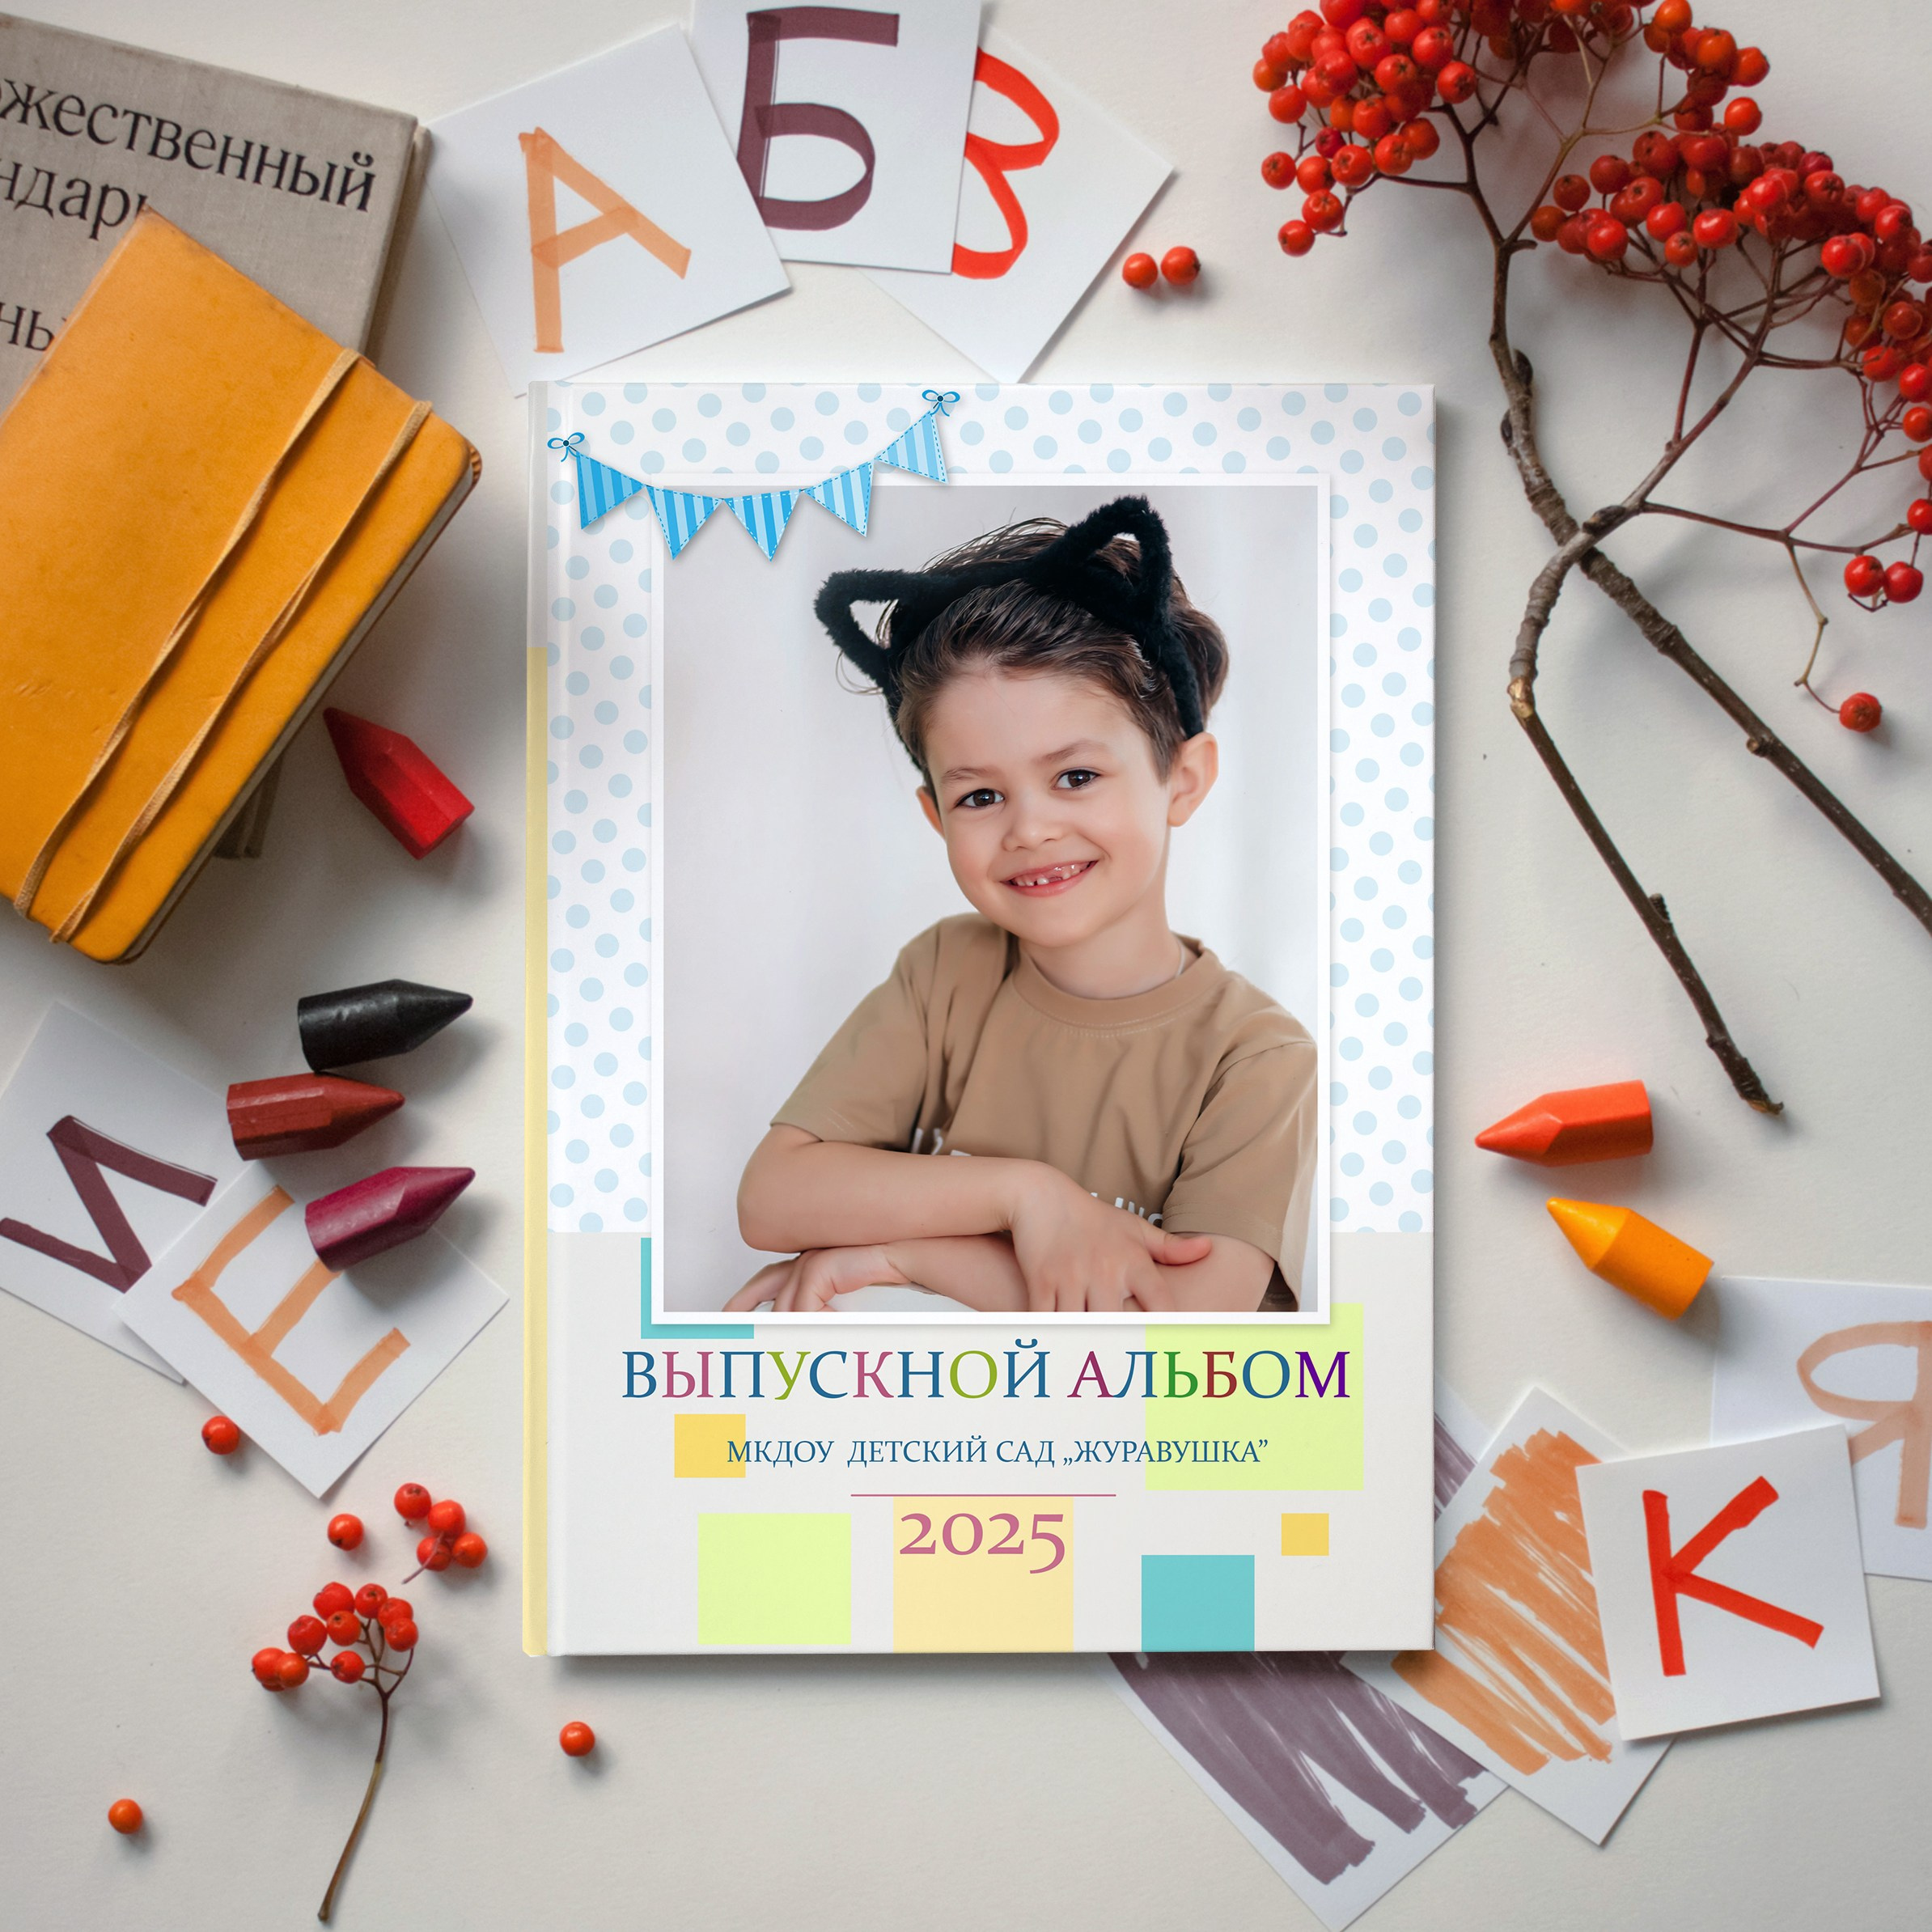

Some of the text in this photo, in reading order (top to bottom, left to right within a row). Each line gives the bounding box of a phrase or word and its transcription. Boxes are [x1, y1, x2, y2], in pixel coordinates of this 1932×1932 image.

[0, 78, 376, 213] жественный
[735, 6, 900, 231] Б
[519, 126, 691, 354] А
[171, 1184, 411, 1436] Е
[622, 1338, 1350, 1400] ВЫПУСКНОЙ АЛЬБОМ
[727, 1441, 835, 1468] МКДОУ
[847, 1434, 987, 1468] ДЕТСКИЙ
[996, 1440, 1055, 1468] САД
[900, 1512, 1066, 1574] 2025
[1642, 1476, 1824, 1677] К
